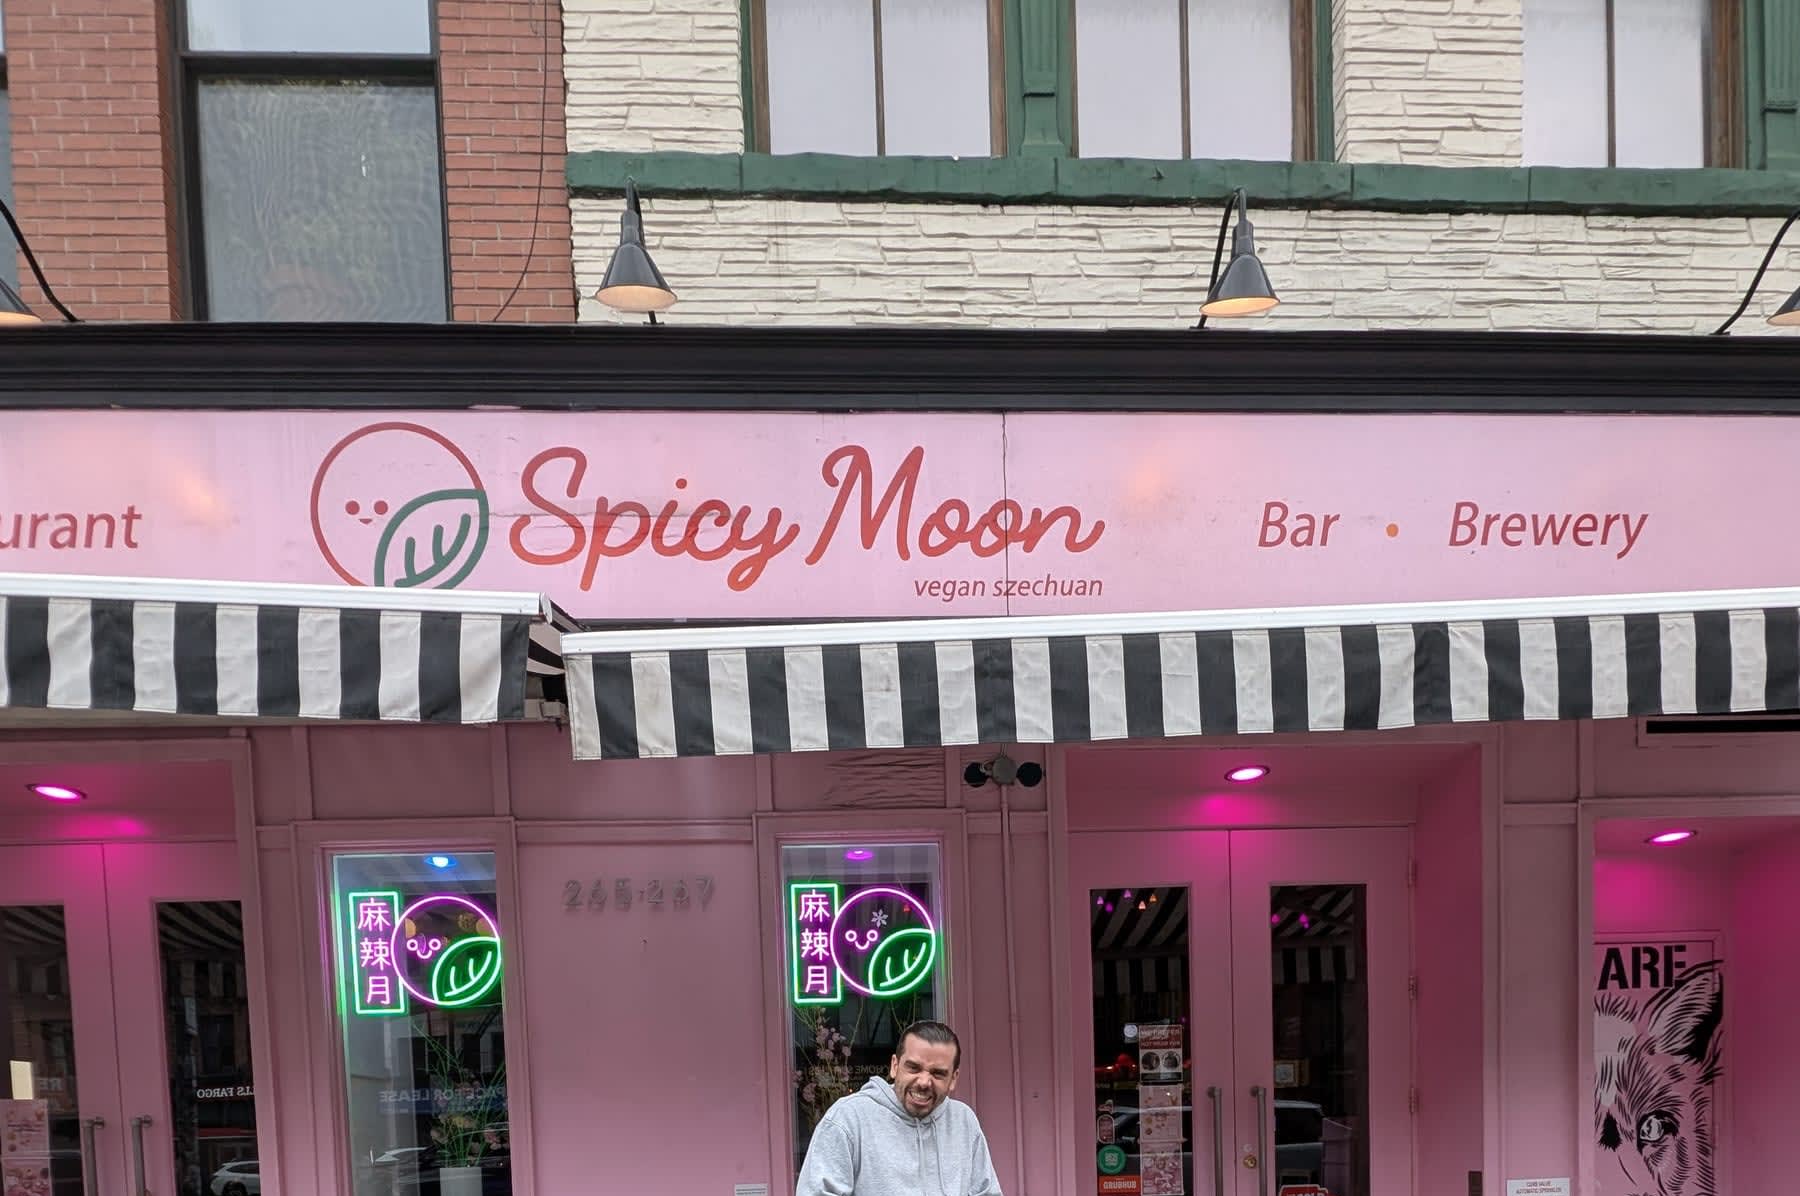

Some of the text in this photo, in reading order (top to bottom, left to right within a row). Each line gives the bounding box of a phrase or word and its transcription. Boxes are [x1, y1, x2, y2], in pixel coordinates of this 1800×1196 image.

[509, 445, 1106, 592] Spicy Moon
[1257, 501, 1649, 560] Bar Brewery
[914, 573, 1104, 603] vegan szechuan
[358, 897, 392, 1005] 麻辣月
[799, 888, 831, 995] 麻辣月
